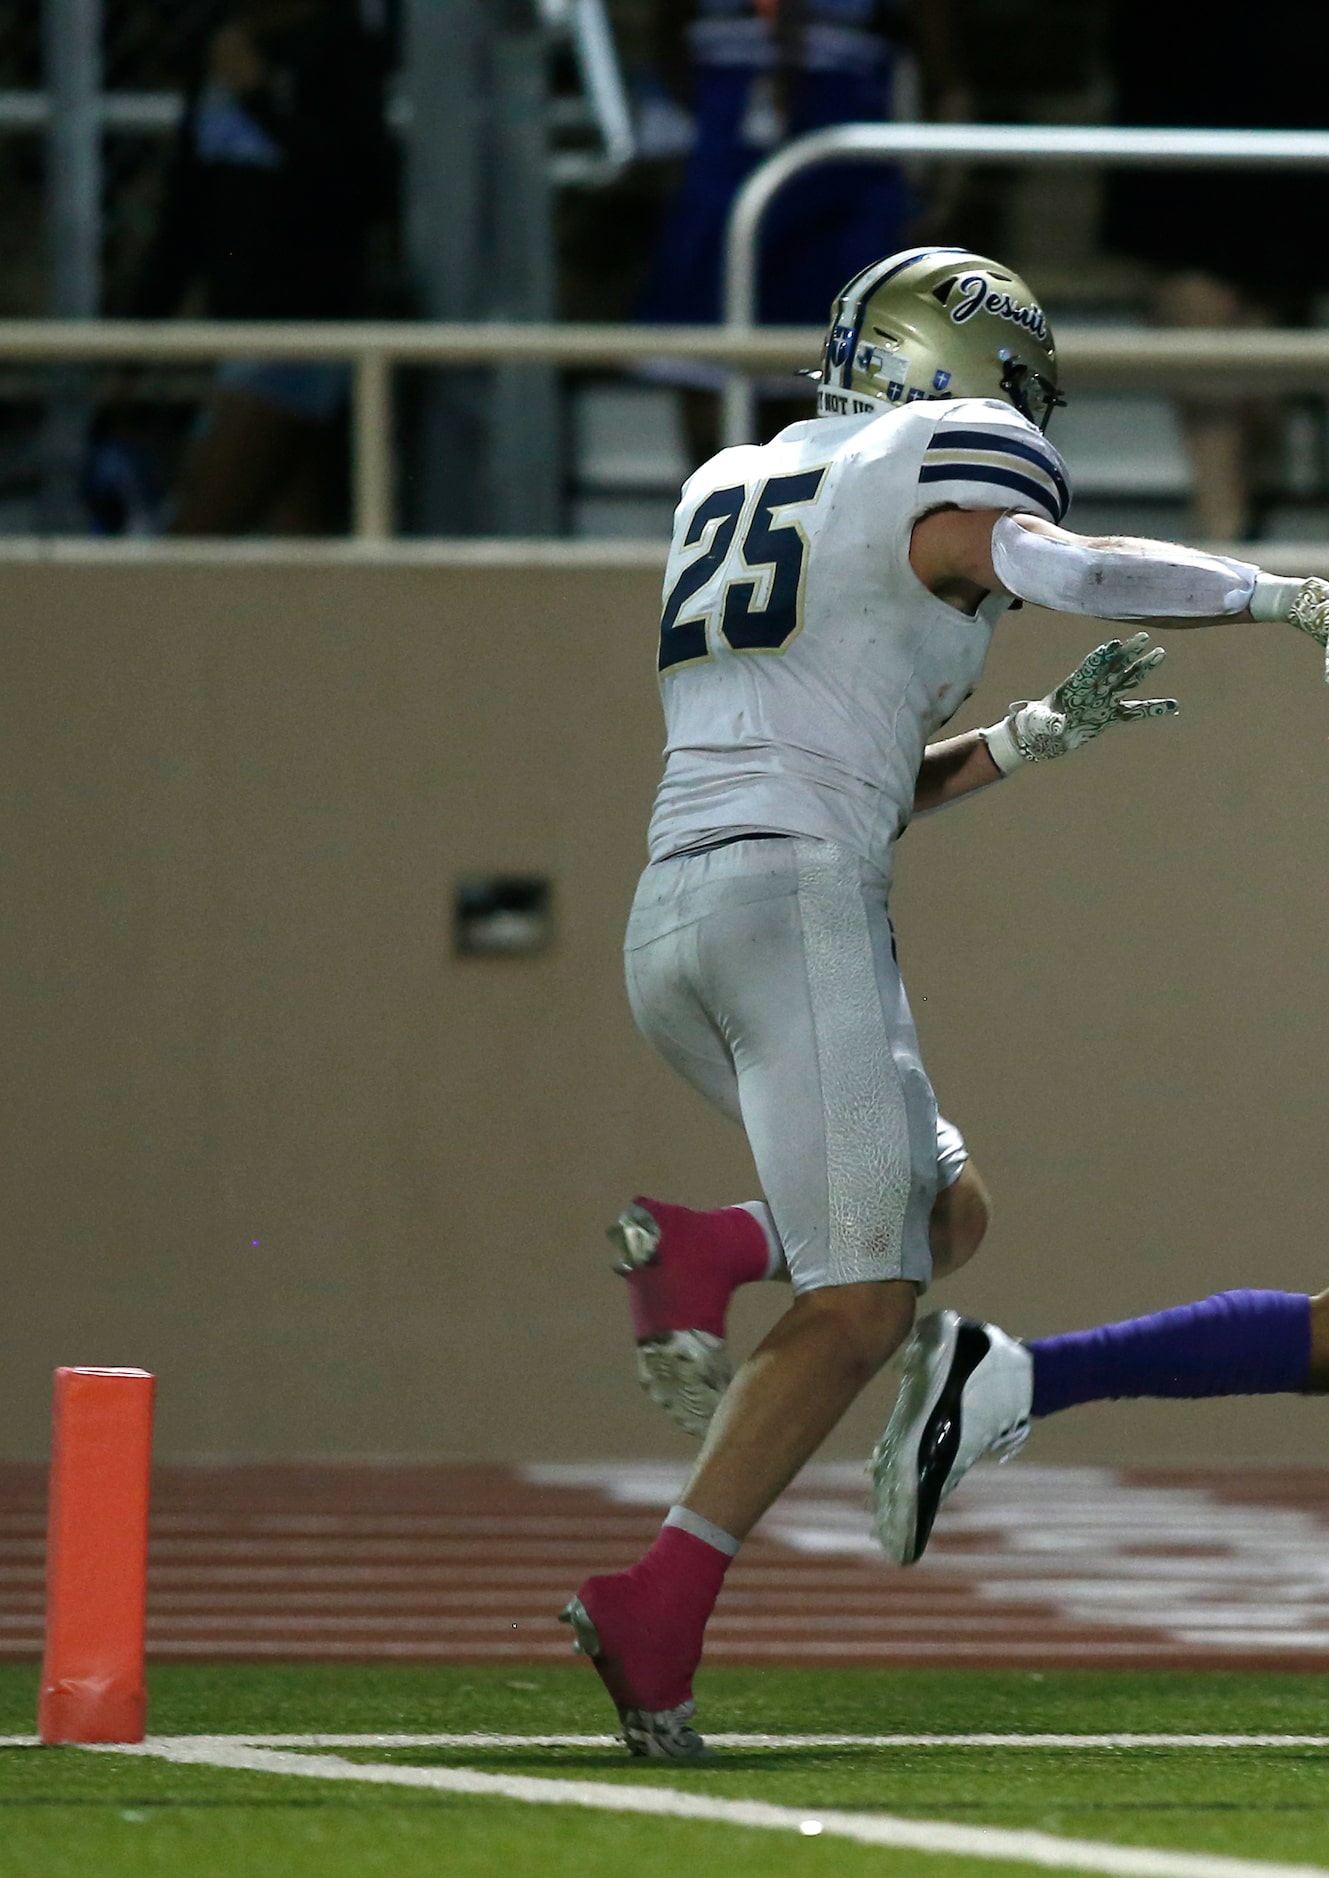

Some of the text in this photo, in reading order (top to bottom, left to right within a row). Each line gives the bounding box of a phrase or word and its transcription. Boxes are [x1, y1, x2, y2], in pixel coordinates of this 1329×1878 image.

[951, 275, 1047, 341] Jesuit
[825, 392, 848, 415] NOT
[657, 461, 833, 676] 25
